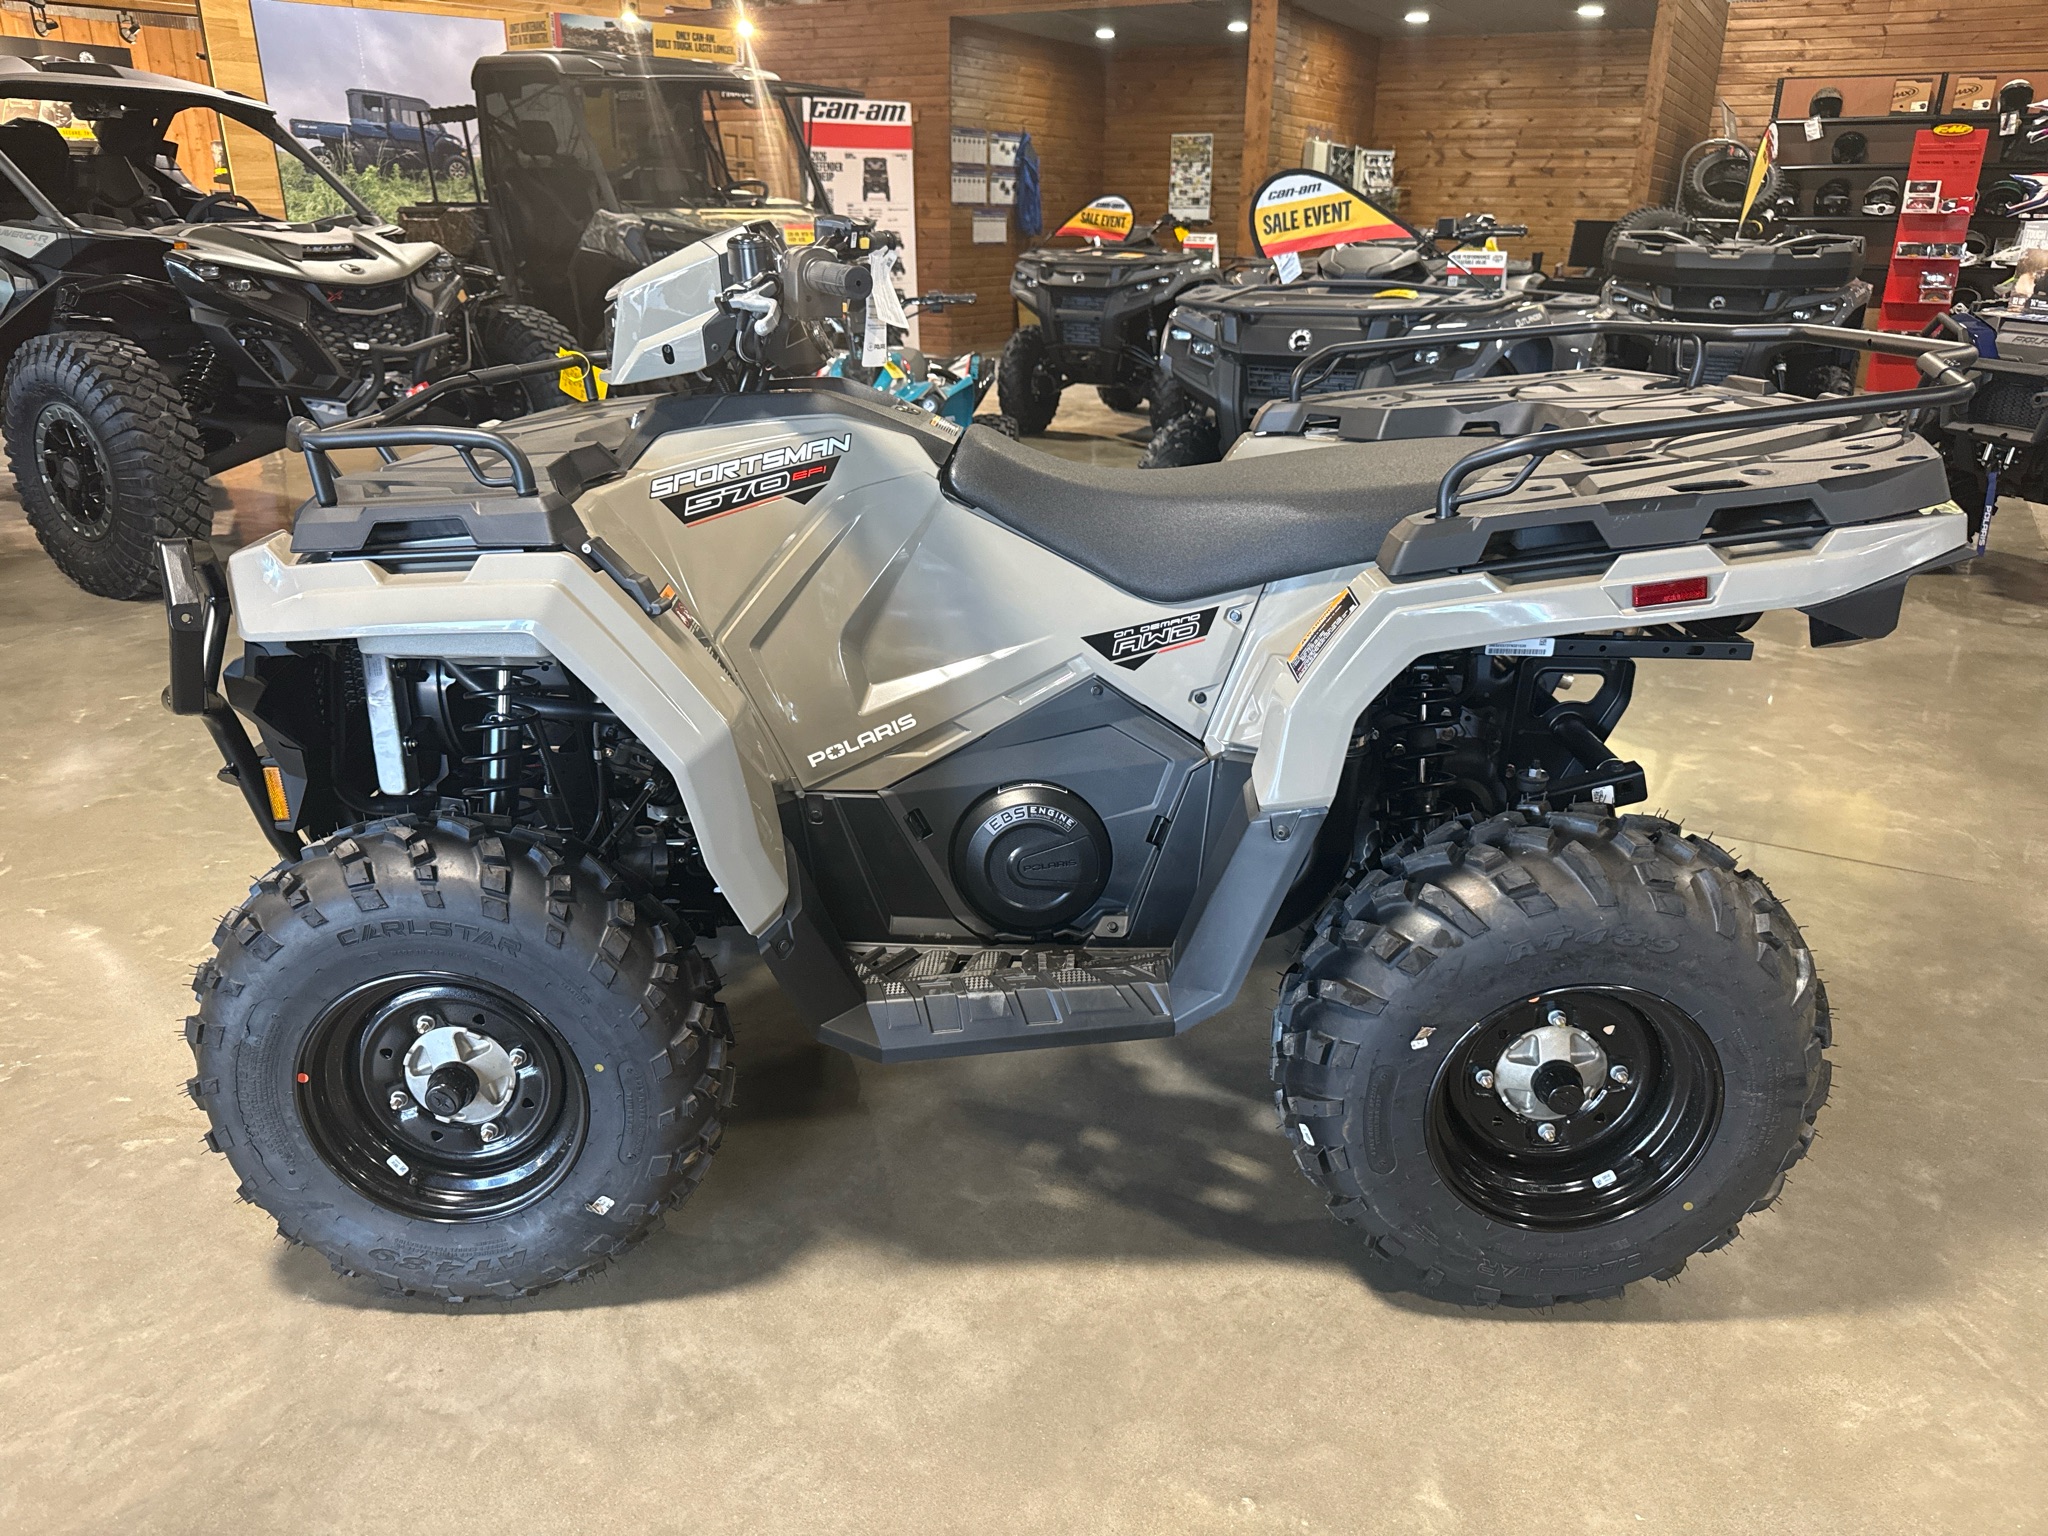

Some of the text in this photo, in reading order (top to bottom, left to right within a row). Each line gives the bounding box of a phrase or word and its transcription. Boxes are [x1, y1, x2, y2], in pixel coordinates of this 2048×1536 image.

[656, 39, 671, 49] BUILT
[811, 101, 906, 122] can-am
[1267, 182, 1323, 202] can-am
[1080, 211, 1126, 229] SALE EVENT
[1262, 200, 1353, 236] SALE EVENT
[650, 432, 852, 499] SPORTSMAN
[684, 465, 827, 517] 570 EFI
[1978, 505, 1993, 547] POLARIS
[1112, 621, 1200, 656] AWD
[1113, 613, 1201, 639] ON DEMAND
[807, 713, 917, 768] POLARIS
[989, 806, 1075, 832] EBS ENGINE
[1023, 859, 1078, 873] POLARIS
[336, 918, 522, 958] CARLSTAR
